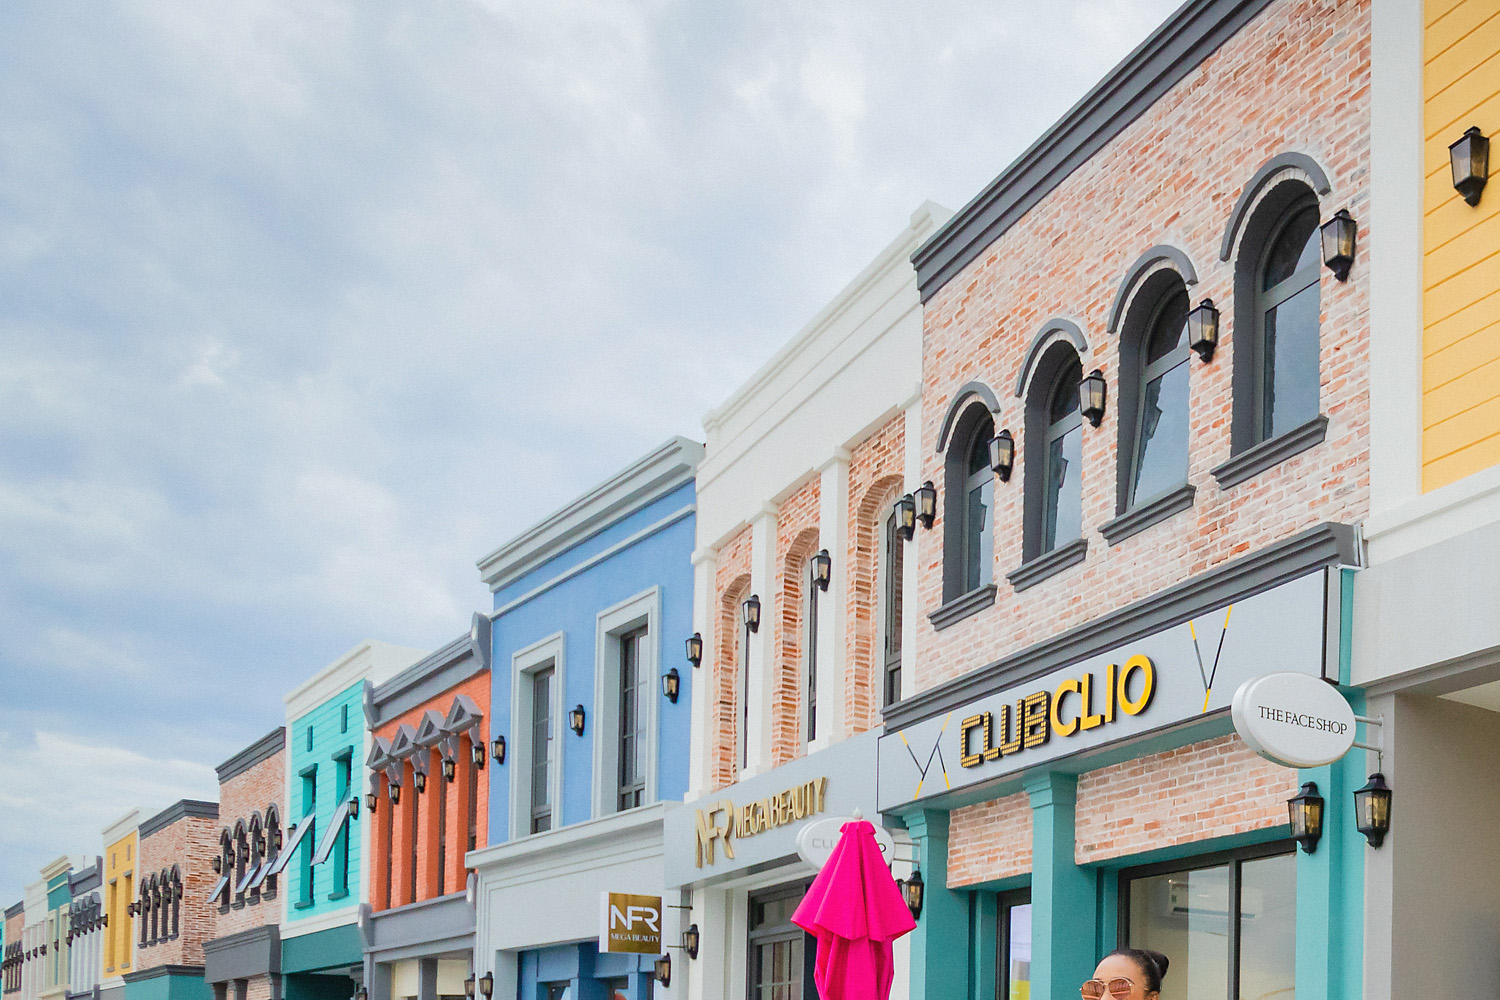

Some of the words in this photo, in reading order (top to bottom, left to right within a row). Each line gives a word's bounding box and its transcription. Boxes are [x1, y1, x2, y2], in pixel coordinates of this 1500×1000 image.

[1258, 705, 1284, 722] THE
[1285, 711, 1315, 729] FACE
[1316, 717, 1348, 735] SHOP
[735, 798, 772, 839] MEGA
[771, 776, 828, 828] BEAUTY
[695, 799, 735, 869] NFR
[610, 904, 660, 933] NFR
[611, 932, 631, 941] MEGA
[632, 934, 660, 943] BEAUTY
